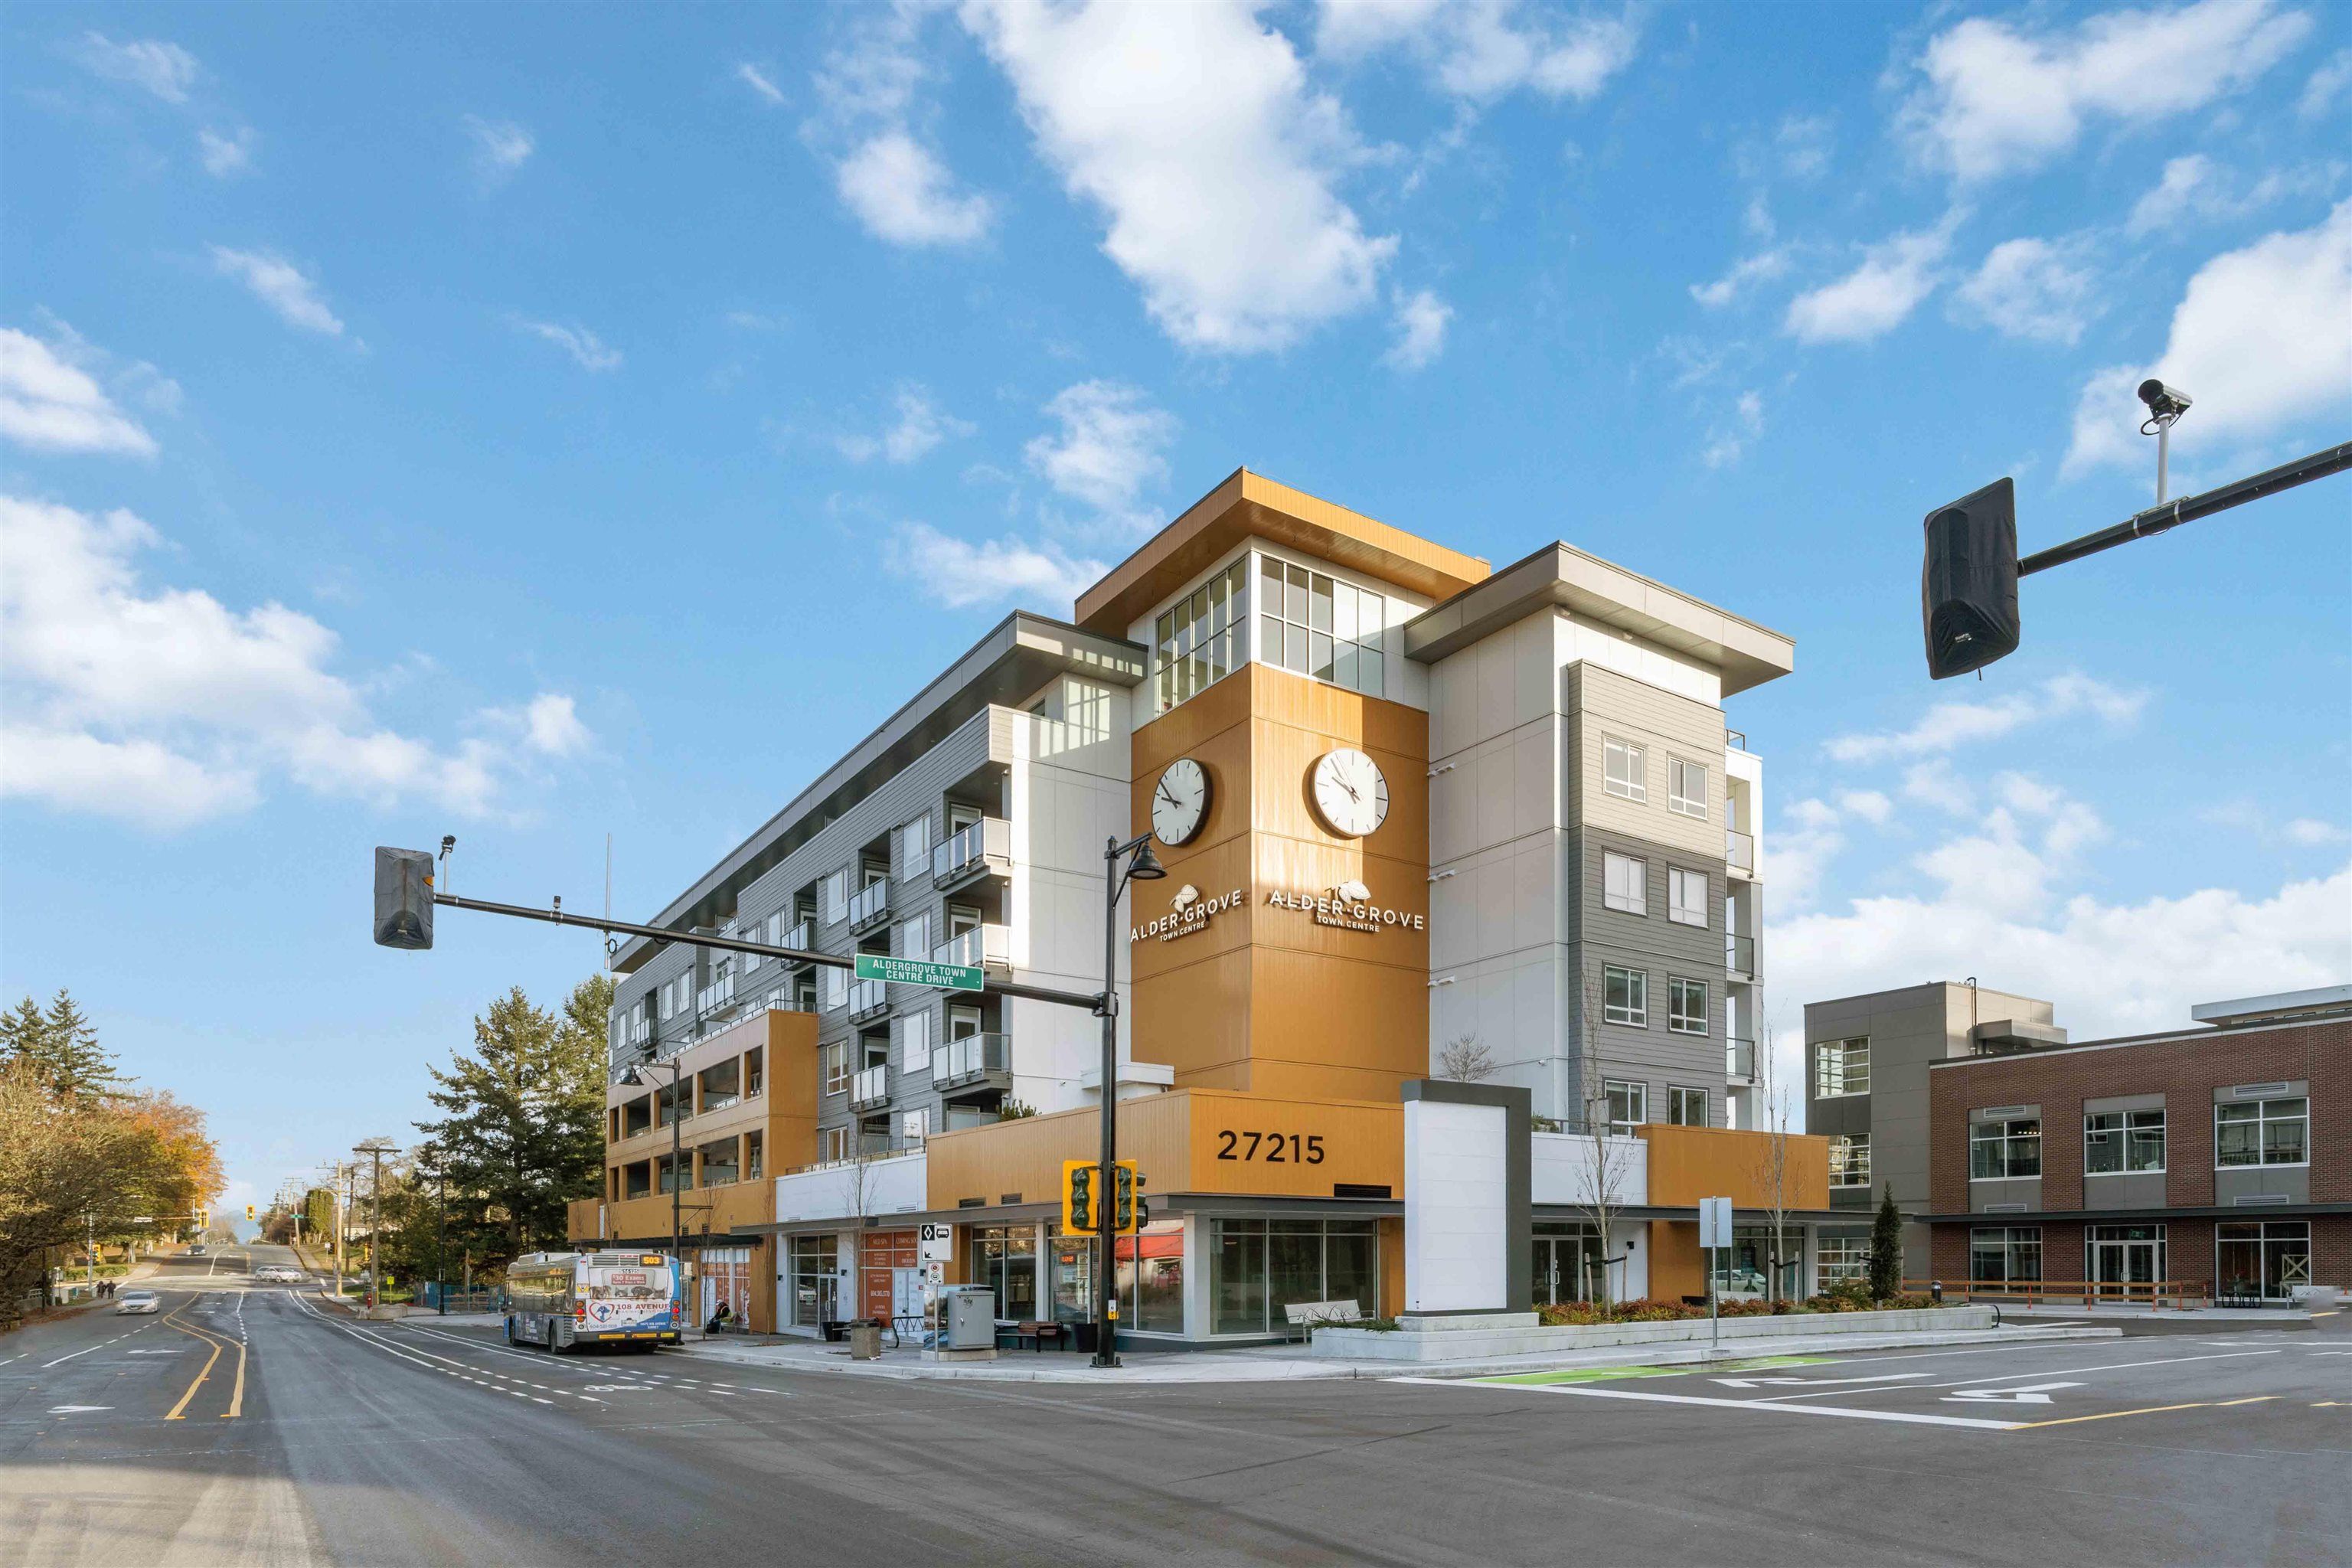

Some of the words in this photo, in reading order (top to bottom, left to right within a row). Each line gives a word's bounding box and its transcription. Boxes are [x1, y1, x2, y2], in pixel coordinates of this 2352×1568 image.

[1159, 929, 1179, 942] TOWN
[1179, 920, 1205, 937] CENTRE
[1316, 915, 1344, 926] TOWN
[1346, 919, 1380, 933] CENTRE
[873, 959, 936, 975] ALDERGROVE
[939, 966, 966, 978] TOWN
[886, 969, 923, 982] CENTRE
[926, 973, 954, 985] DRIVE
[1217, 1129, 1325, 1165] 27215
